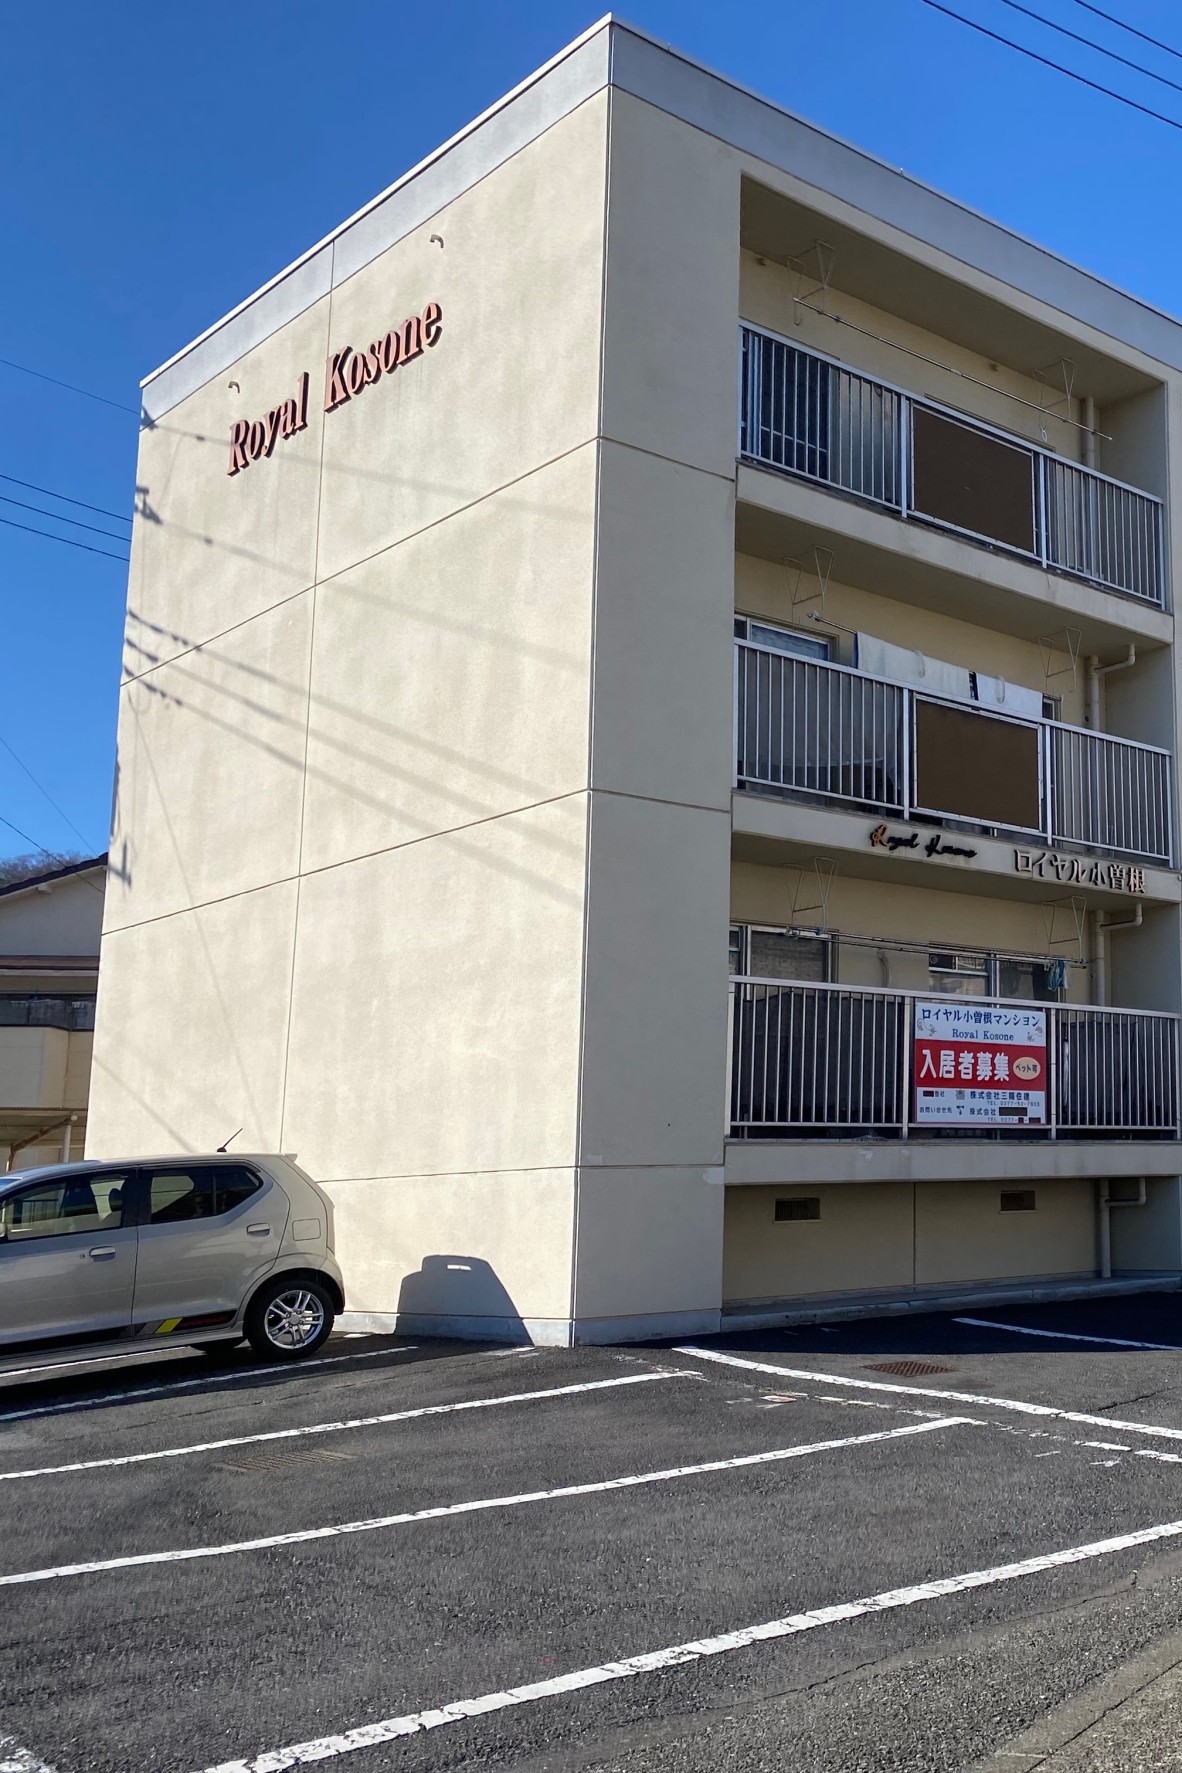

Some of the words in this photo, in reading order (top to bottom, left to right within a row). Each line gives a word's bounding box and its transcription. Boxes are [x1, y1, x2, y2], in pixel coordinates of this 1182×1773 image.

[227, 371, 310, 477] Royal
[323, 302, 443, 414] Kosone
[1014, 849, 1146, 894] ロイヤル小曽根
[922, 1008, 1040, 1028] ロイヤル小曽根マンション
[952, 1028, 979, 1040] Royal
[983, 1030, 1015, 1042] Kosone
[919, 1049, 1010, 1082] 入居者募集
